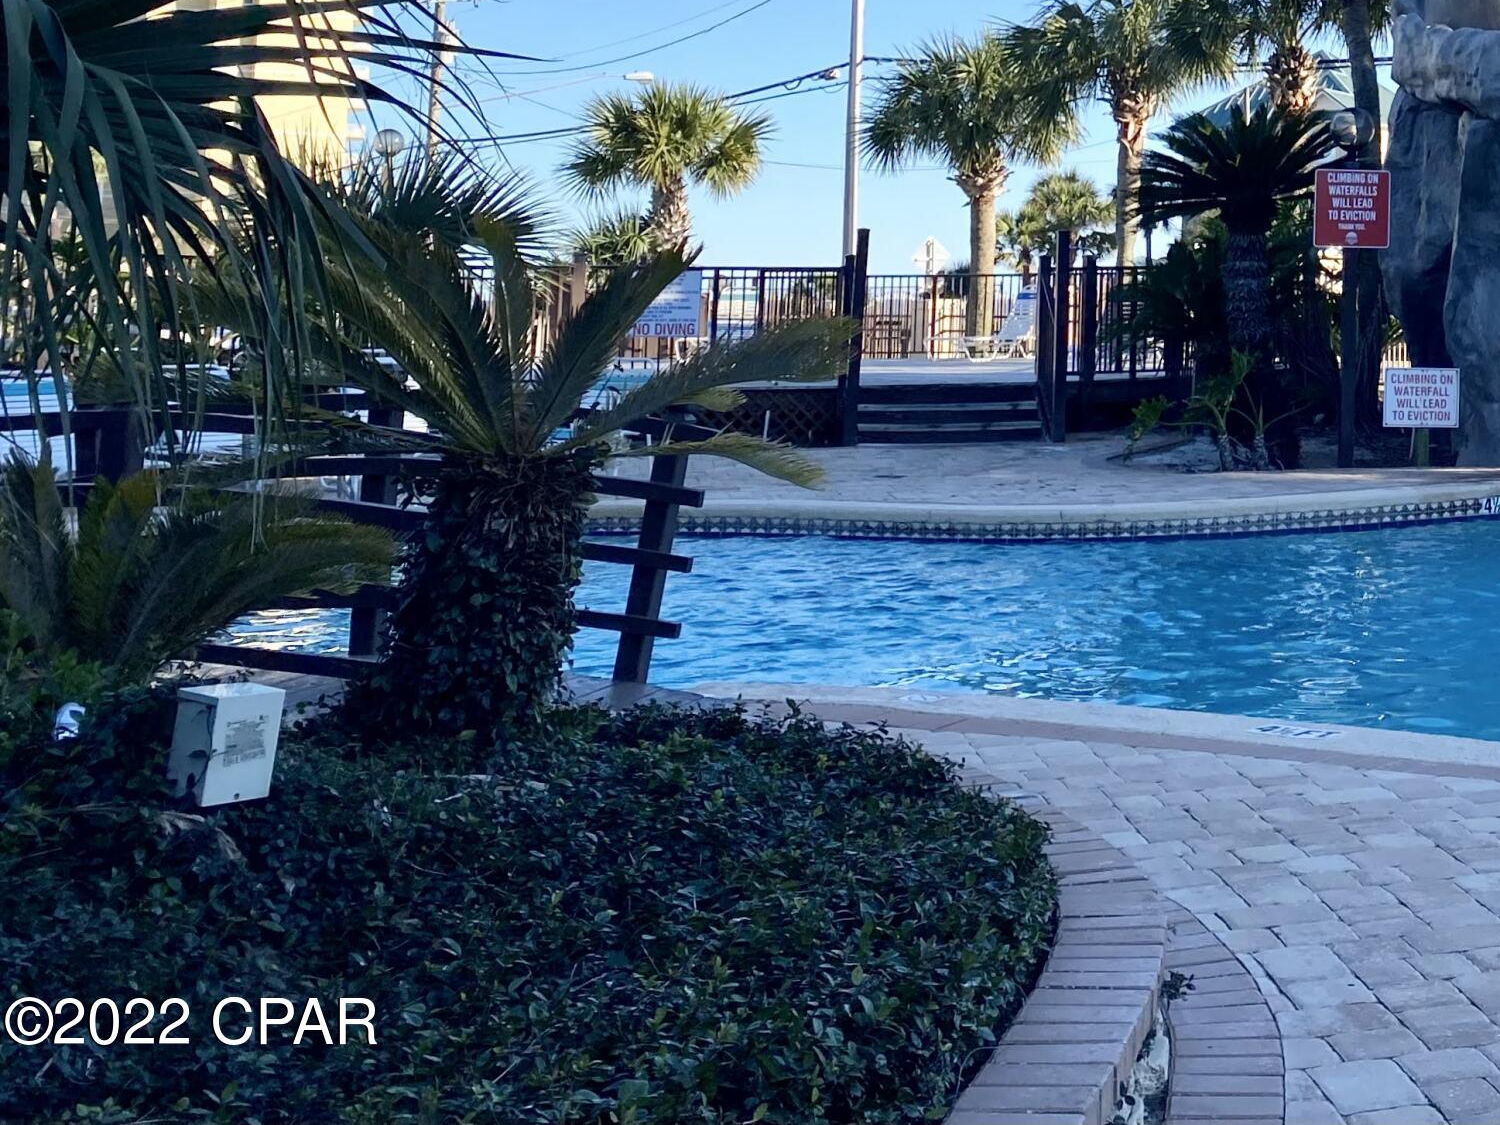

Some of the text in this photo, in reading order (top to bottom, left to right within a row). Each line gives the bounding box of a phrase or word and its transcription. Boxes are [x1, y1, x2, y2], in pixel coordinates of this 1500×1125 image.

[1327, 172, 1379, 184] CLIMBING ON
[1328, 185, 1378, 196] WATERFALLS
[1332, 197, 1373, 208] WILL LEAD
[1328, 209, 1376, 221] TO EVICTION
[633, 323, 695, 336] NO DIVING
[1391, 374, 1453, 384] CLIMBING ON
[1394, 386, 1450, 396] WATERFALL
[1396, 398, 1447, 409] WILL LEAD
[1392, 410, 1451, 421] TO EVICTION
